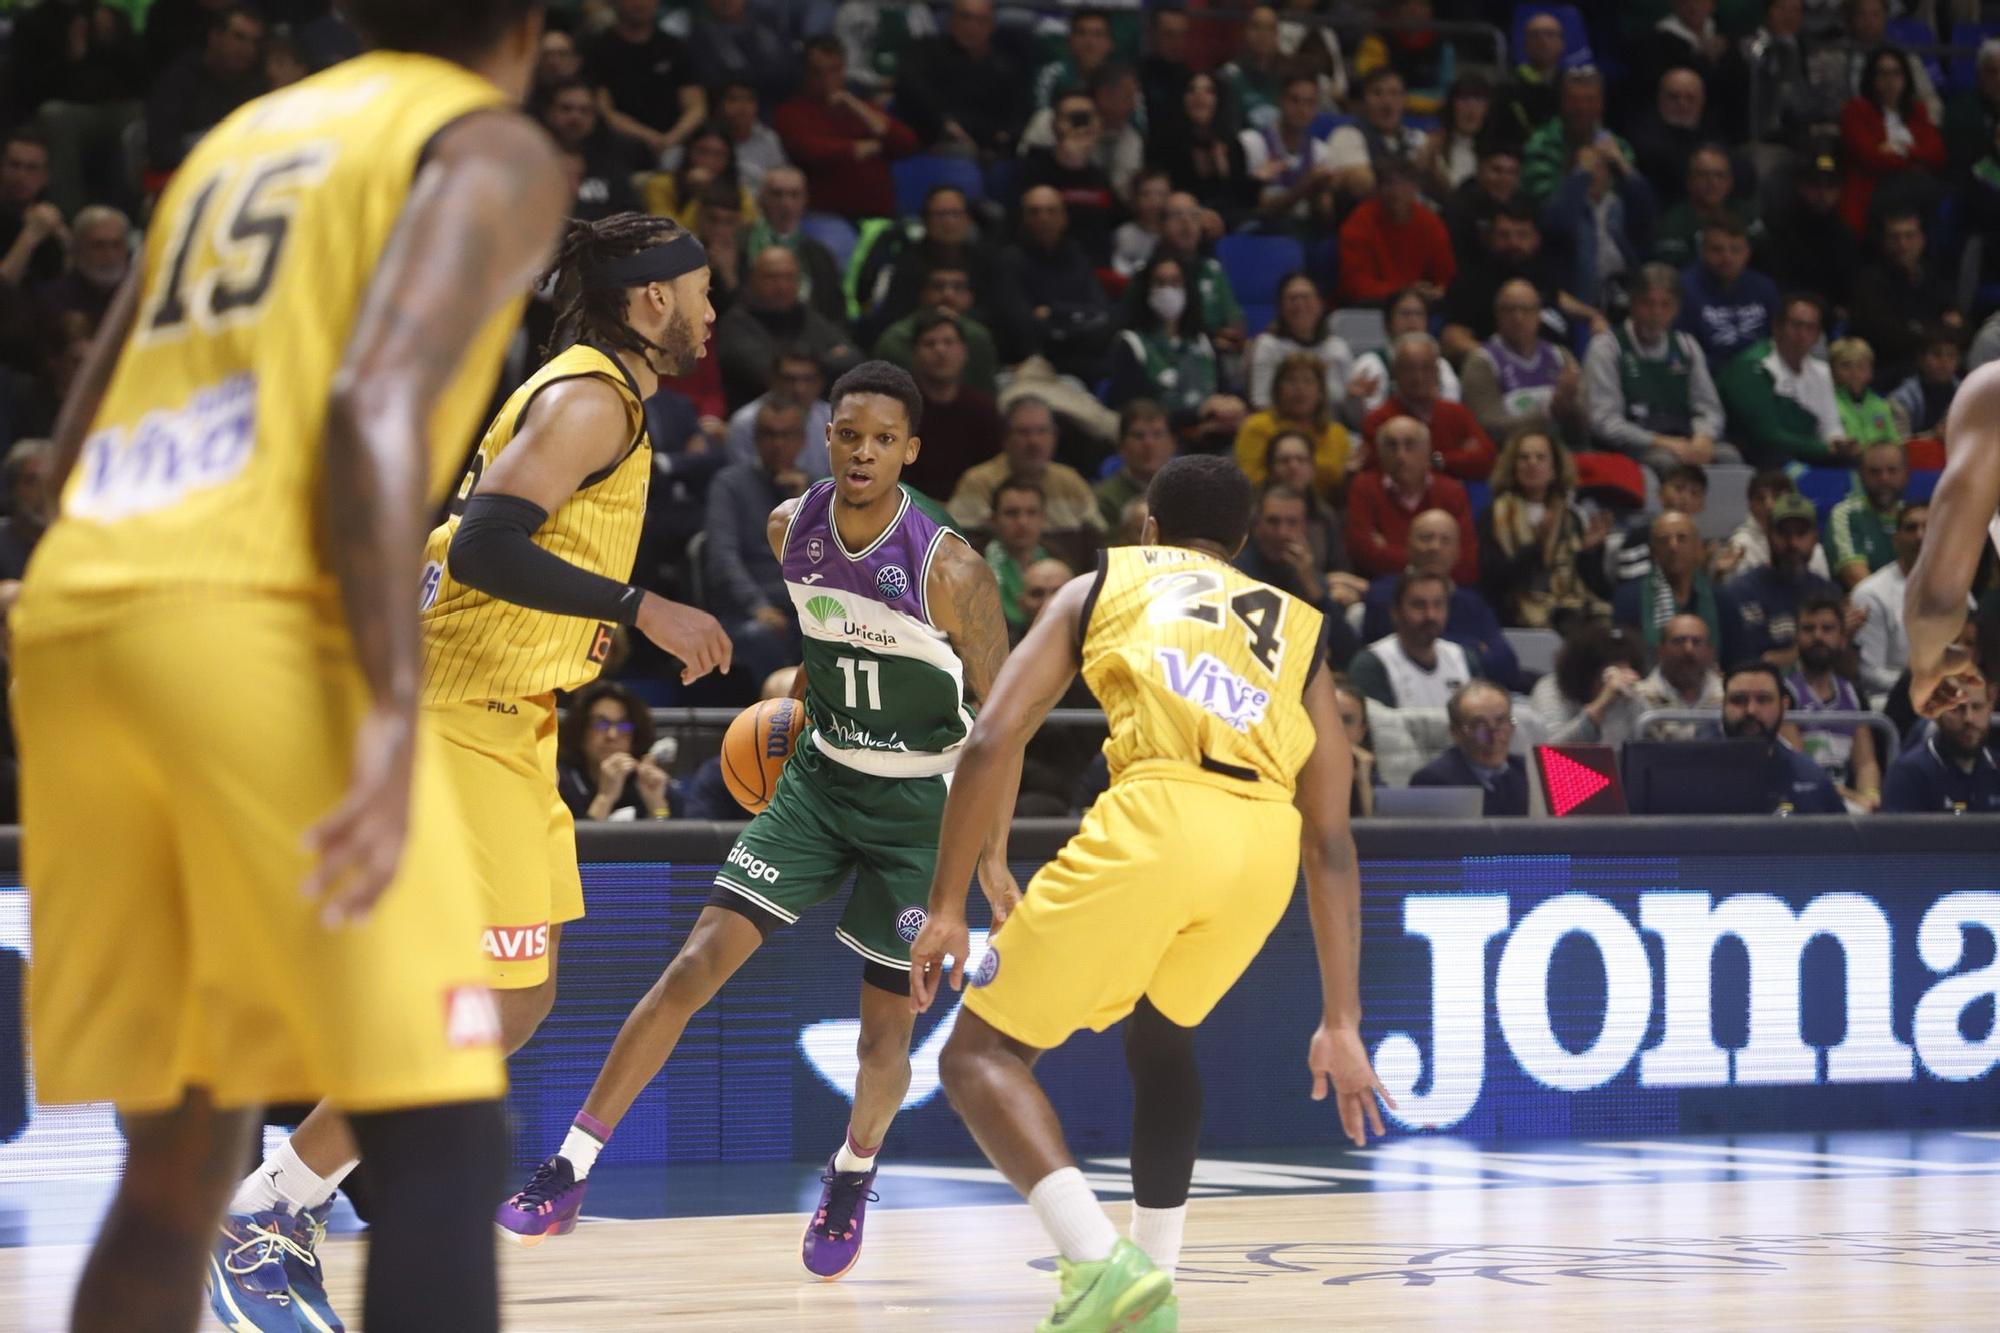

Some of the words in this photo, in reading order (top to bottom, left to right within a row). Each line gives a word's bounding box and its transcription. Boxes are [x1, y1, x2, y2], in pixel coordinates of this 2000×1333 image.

[142, 142, 338, 346] 15
[1148, 570, 1289, 680] 24
[487, 701, 519, 715] FILA
[836, 657, 882, 710] 11
[480, 925, 547, 958] AVIS
